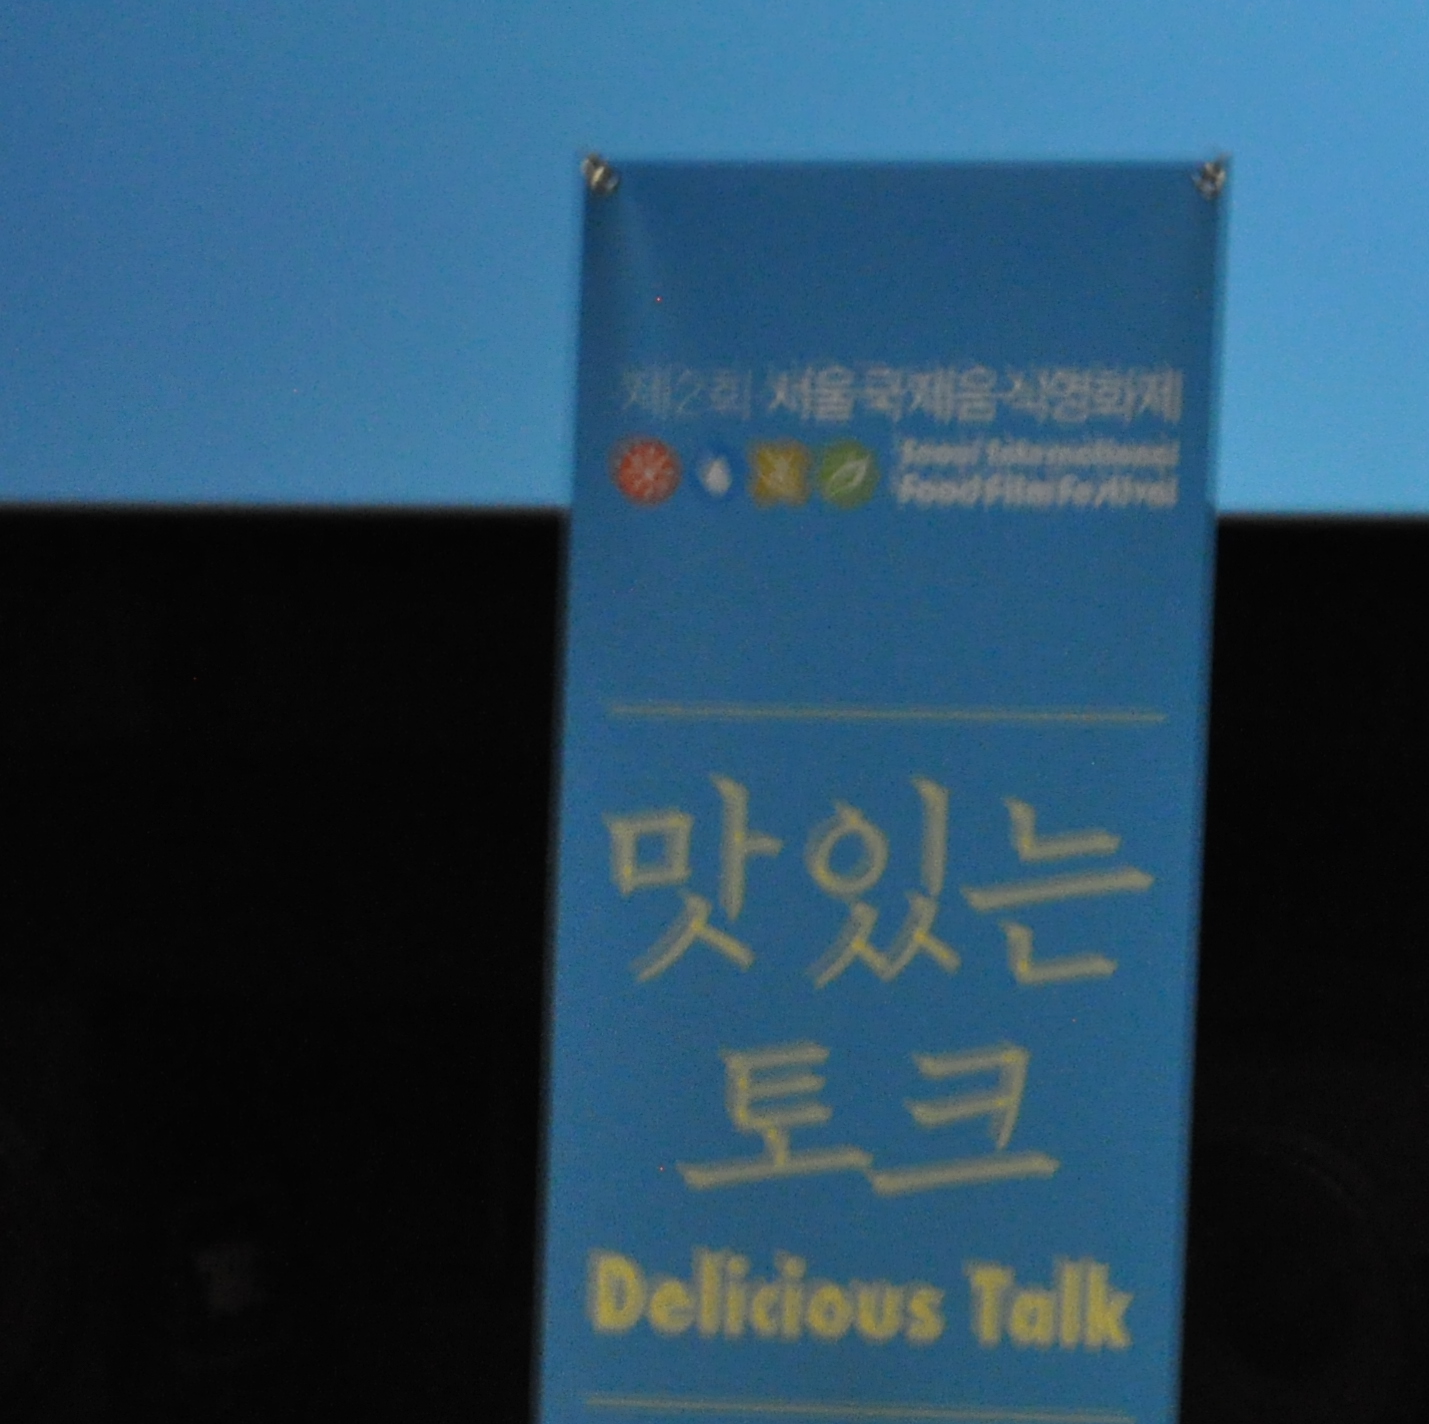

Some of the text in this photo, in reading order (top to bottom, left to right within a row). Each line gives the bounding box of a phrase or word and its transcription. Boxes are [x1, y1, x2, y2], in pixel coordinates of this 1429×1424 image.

[604, 771, 1153, 988] 맛있는
[676, 1040, 1060, 1197] 토크
[588, 1244, 1134, 1349] Delicious Talk
